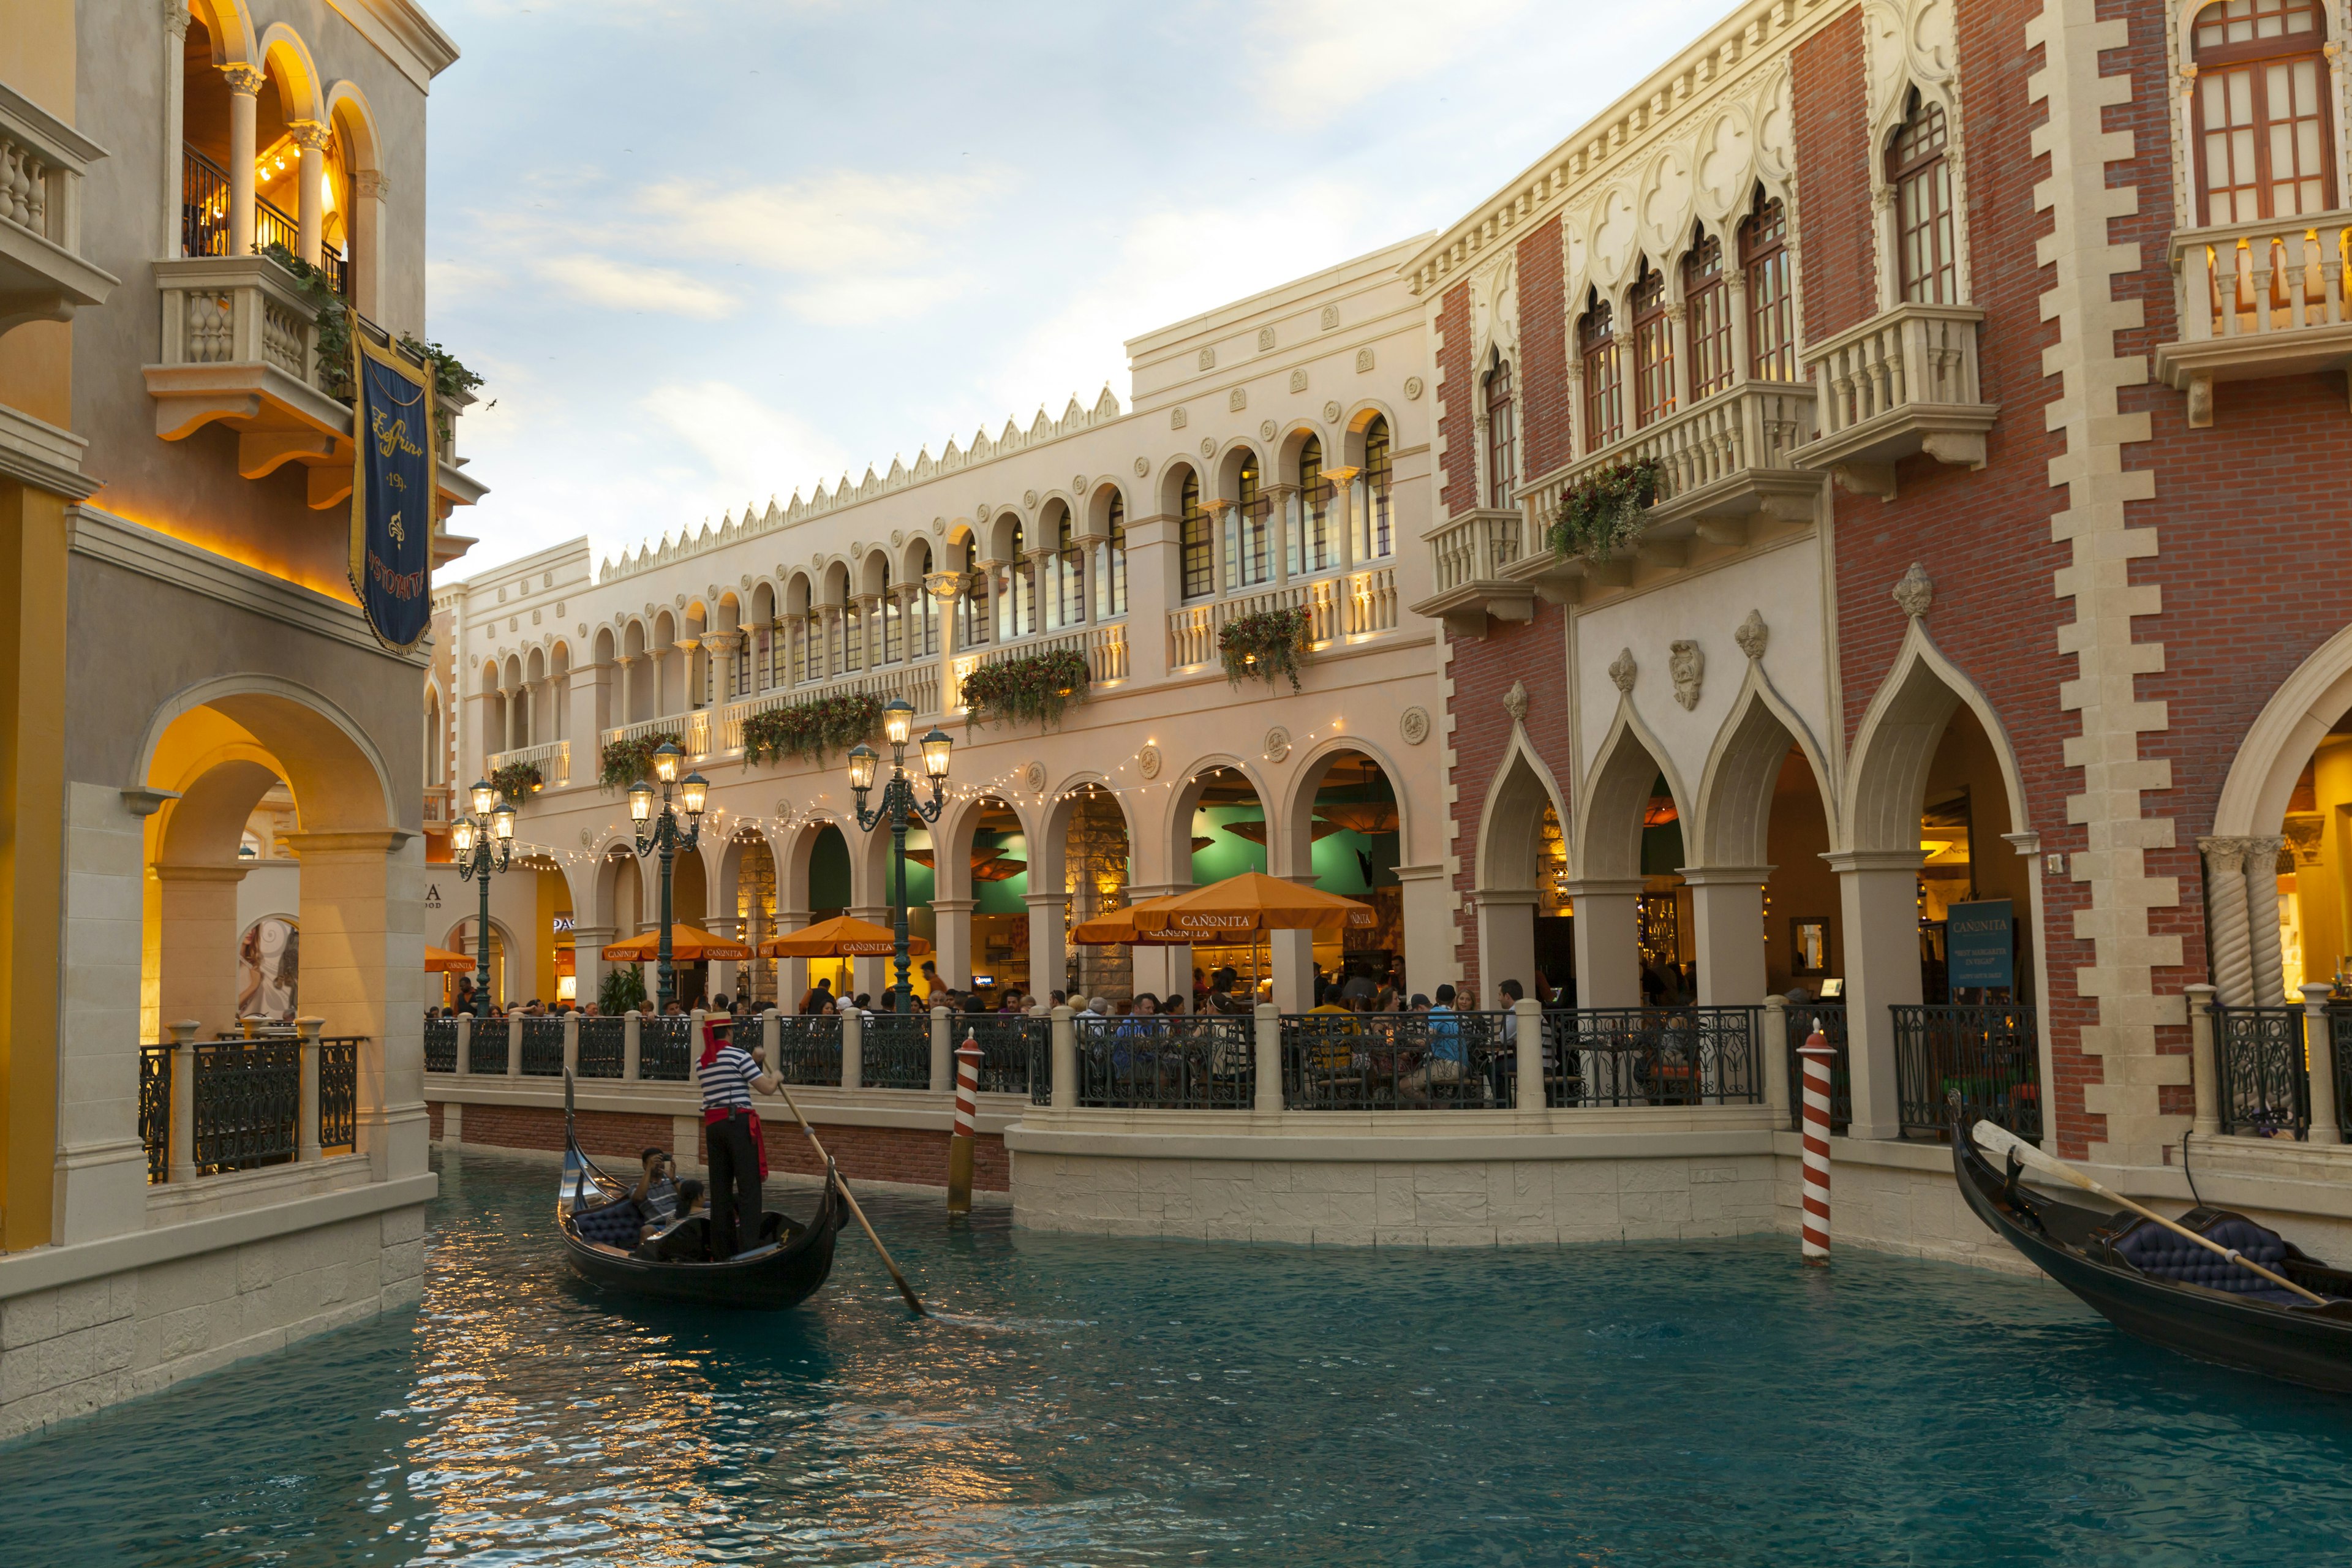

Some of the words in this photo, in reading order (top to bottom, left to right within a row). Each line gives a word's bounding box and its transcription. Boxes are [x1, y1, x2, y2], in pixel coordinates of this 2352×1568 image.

[1181, 914, 1250, 927] CAÑONITA
[1953, 919, 2007, 933] CAÑONITA
[707, 948, 742, 957] CAÑONITA
[843, 943, 892, 951] CAÑONITA
